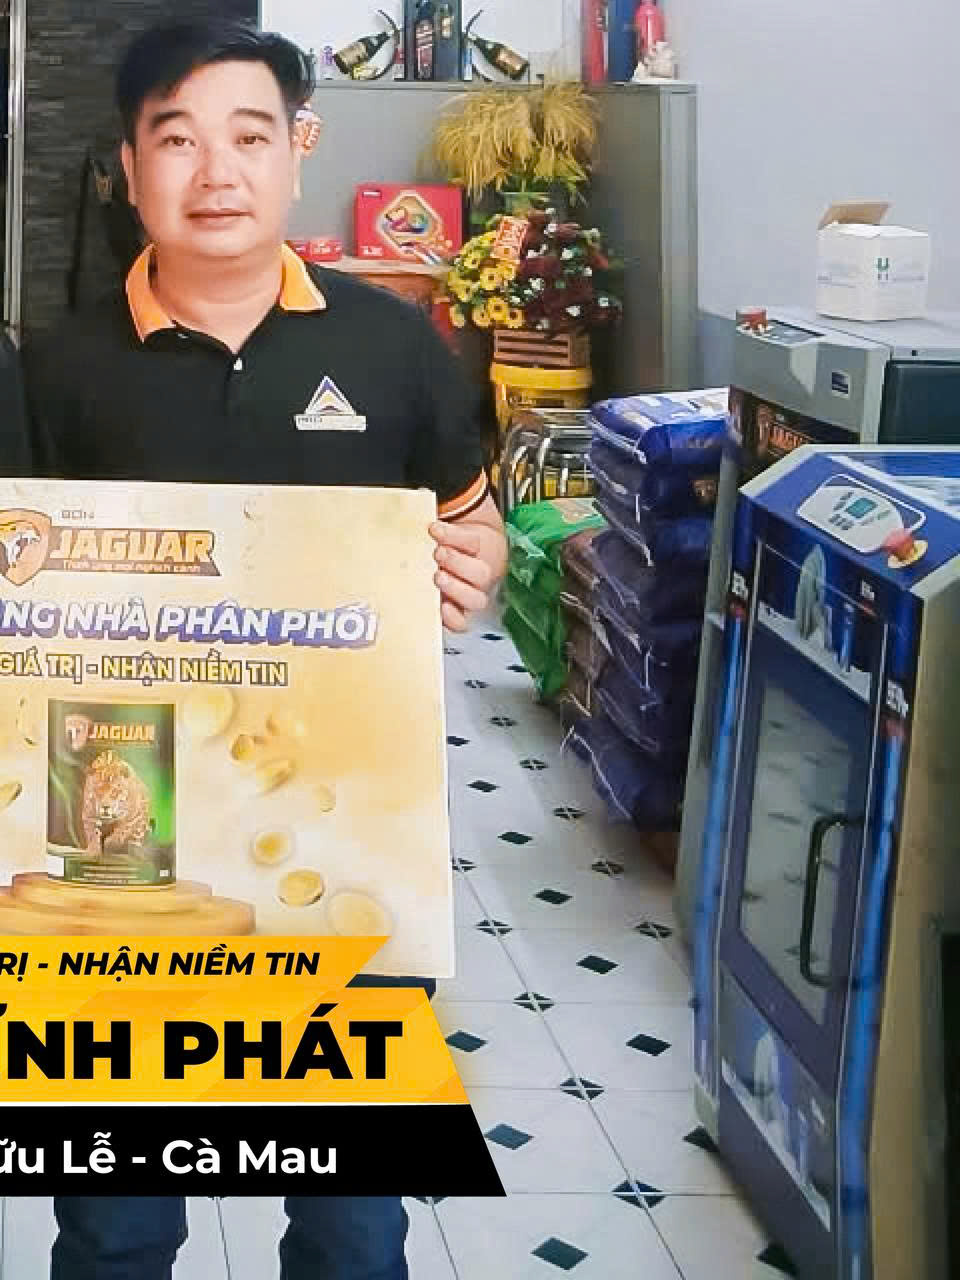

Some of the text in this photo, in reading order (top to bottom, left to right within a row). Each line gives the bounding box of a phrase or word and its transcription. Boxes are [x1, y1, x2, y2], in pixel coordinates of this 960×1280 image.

[50, 528, 214, 563] JAGUAR
[64, 596, 149, 637] NHÀ
[157, 599, 271, 641] PHÂN
[280, 603, 378, 645] PHỐI
[46, 653, 83, 684] TRỊ
[102, 651, 175, 686] NHẬN
[180, 647, 243, 685] NIỀM
[246, 660, 289, 687] TIN
